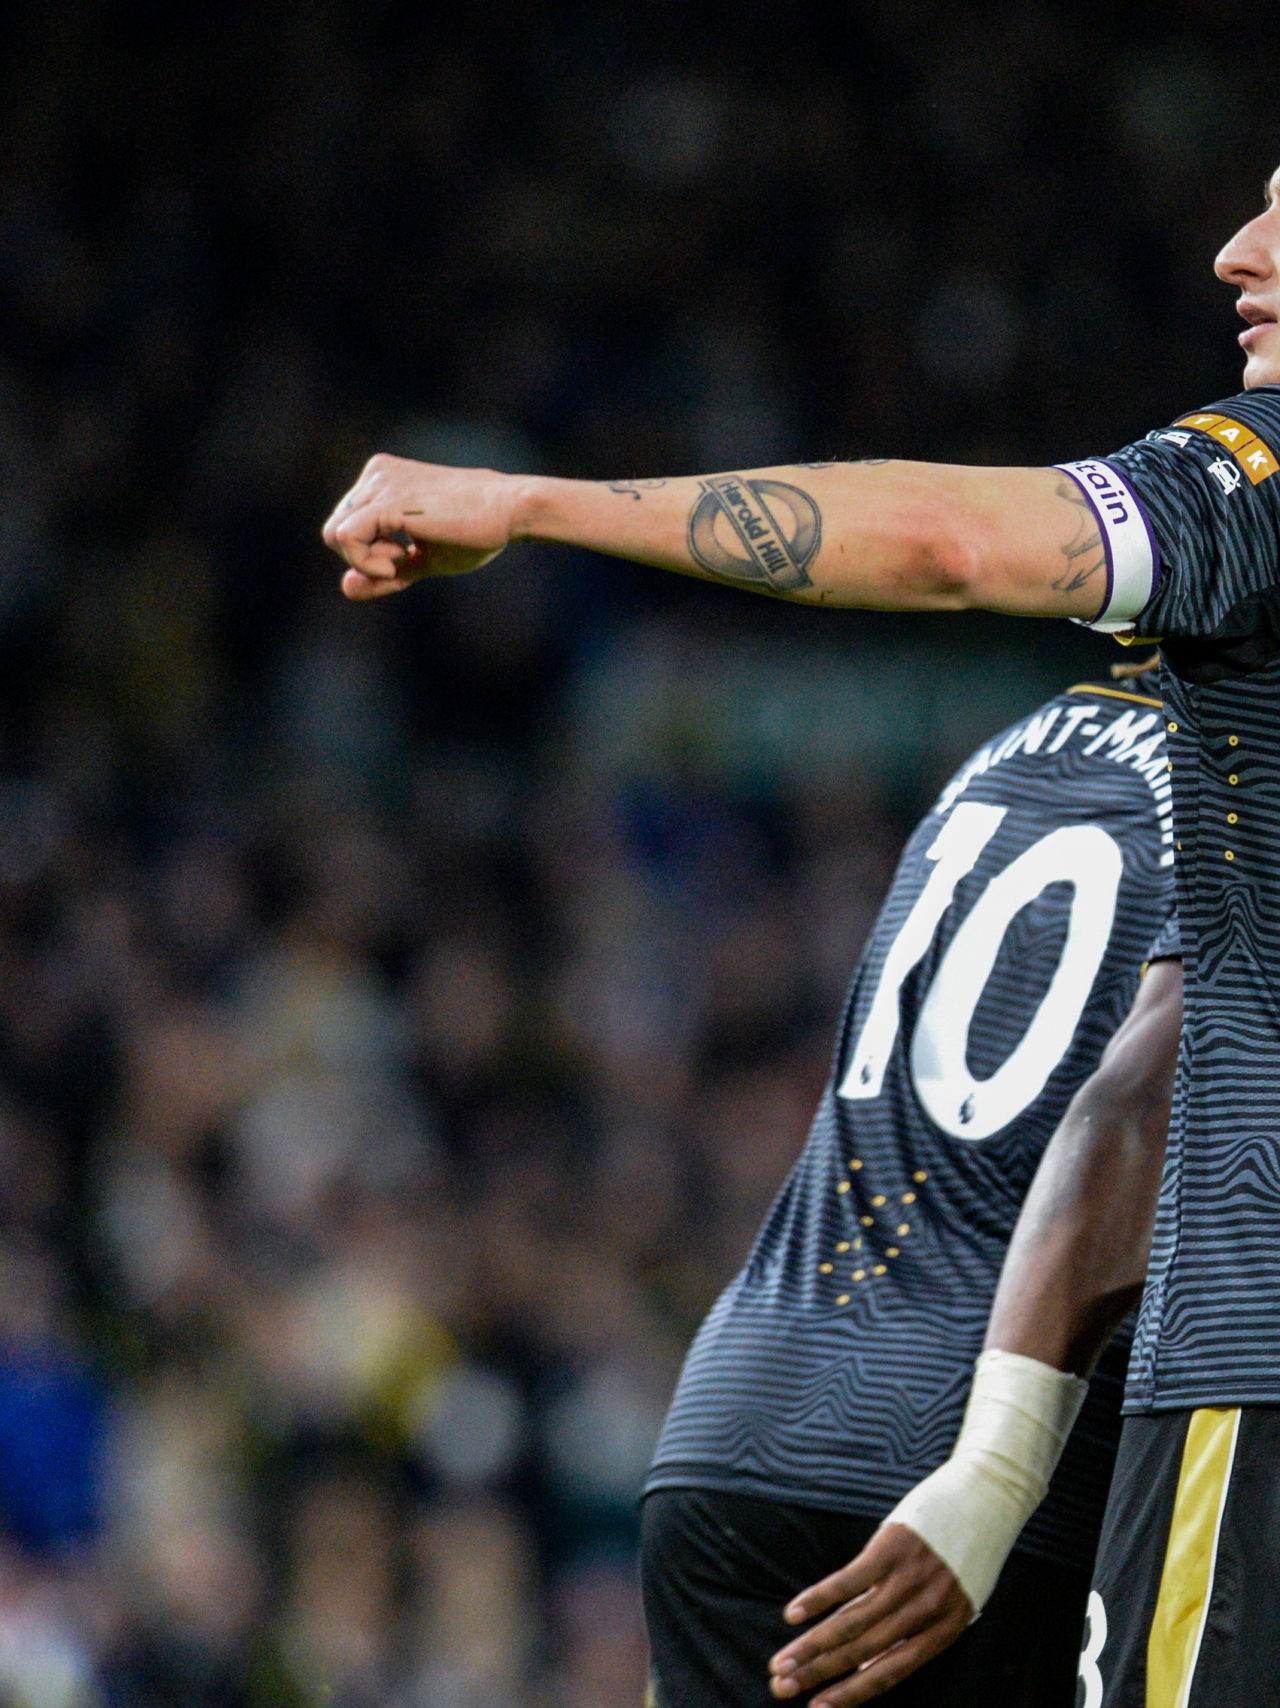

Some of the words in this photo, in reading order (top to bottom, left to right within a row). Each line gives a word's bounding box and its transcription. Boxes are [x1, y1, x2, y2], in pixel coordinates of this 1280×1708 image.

[1173, 416, 1269, 471] YAK
[718, 481, 770, 540] Harold
[757, 540, 789, 573] Hill
[1075, 460, 1129, 525] tain
[838, 801, 1124, 1142] 10
